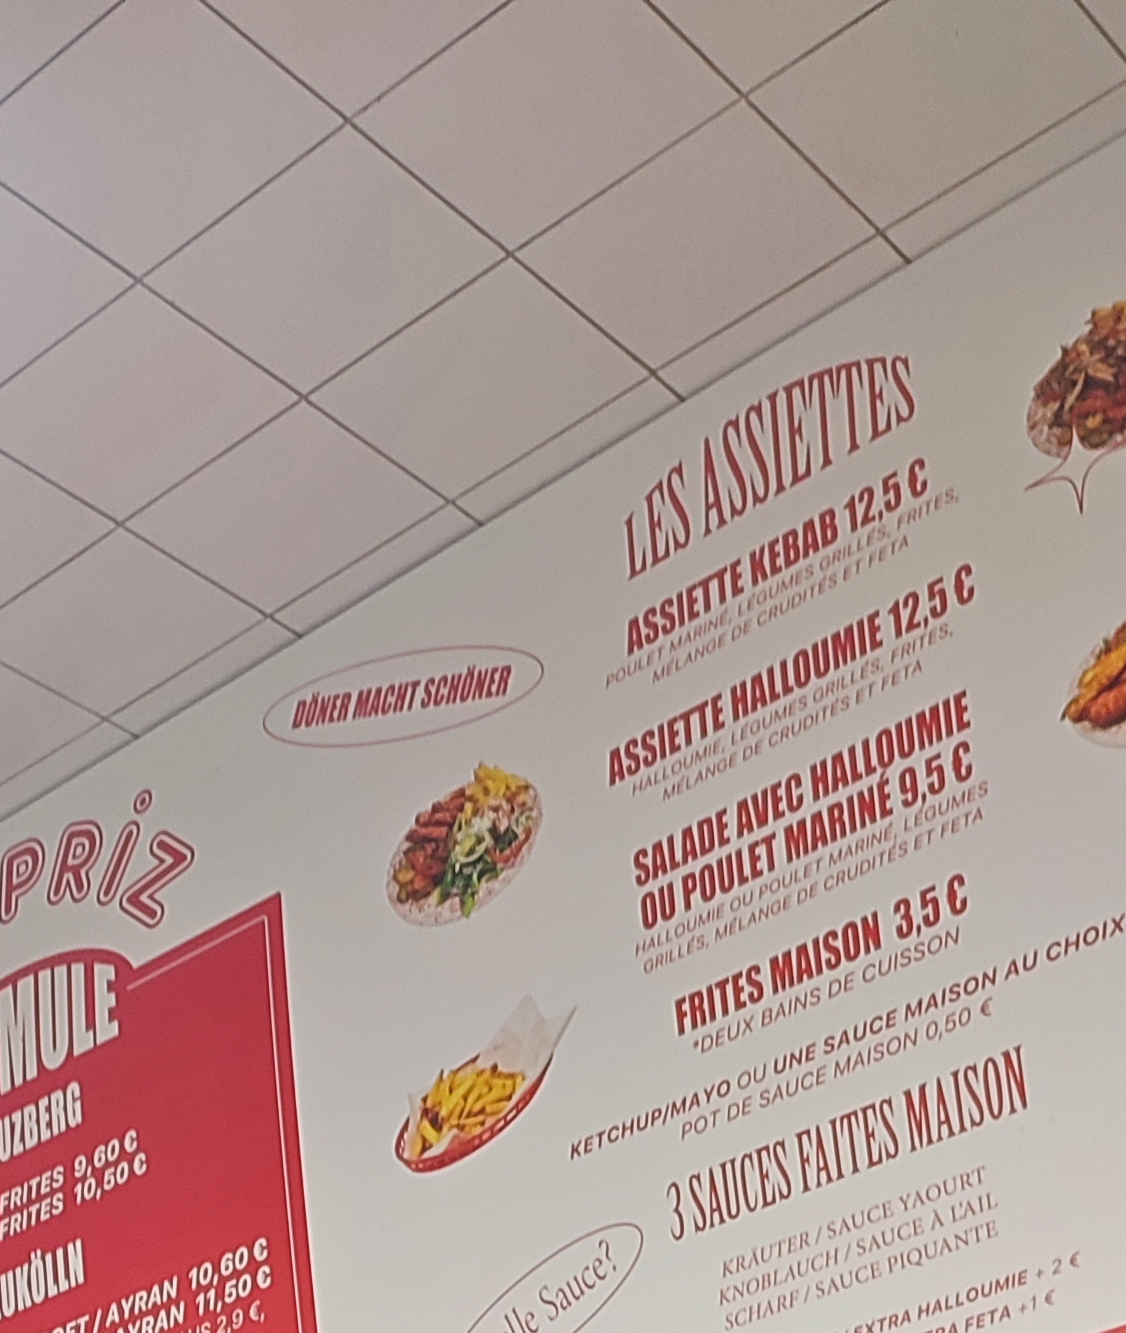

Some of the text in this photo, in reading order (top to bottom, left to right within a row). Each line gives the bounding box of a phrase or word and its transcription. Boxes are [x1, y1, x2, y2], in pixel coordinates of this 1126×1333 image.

[624, 356, 915, 580] LES ASSIETTES
[627, 559, 744, 656] ASSIETTE
[749, 508, 838, 586] KEBAB
[844, 470, 901, 532] 12,5
[292, 665, 511, 729] DÖNER MACHT SCHÖNER
[609, 692, 725, 787] ASSIETTE
[730, 610, 883, 721] HALLOUMIE
[888, 576, 948, 638] 12,5
[633, 690, 971, 886] SALADE AVEC HALLOUMIE
[640, 882, 675, 929] OU
[681, 832, 776, 910] POULET
[778, 771, 893, 862] MARINÉ
[899, 752, 945, 807] 9,5
[675, 965, 764, 1035] FRITES
[769, 911, 881, 994] MAISON
[893, 884, 940, 939] 3,5
[761, 987, 820, 1027] BAINS
[828, 971, 854, 999] DE
[861, 925, 959, 983] CUISSON
[570, 913, 1125, 1160] KETCHUP/MAYO OU UNE SAUCE MAISON AU CHOIX
[0, 1166, 63, 1215] FRITES
[74, 1139, 119, 1177] 9,60
[74, 1161, 128, 1204] 10,50
[666, 1048, 1027, 1241] 3 SAUCES FAITES MAISON
[105, 1276, 177, 1327] AYRAN
[189, 1247, 248, 1289] 10,60
[538, 1239, 617, 1321] Sauce?
[722, 1231, 810, 1278] KRÄUTER
[826, 1200, 893, 1239] SAUCE
[898, 1165, 985, 1212] YAOURT
